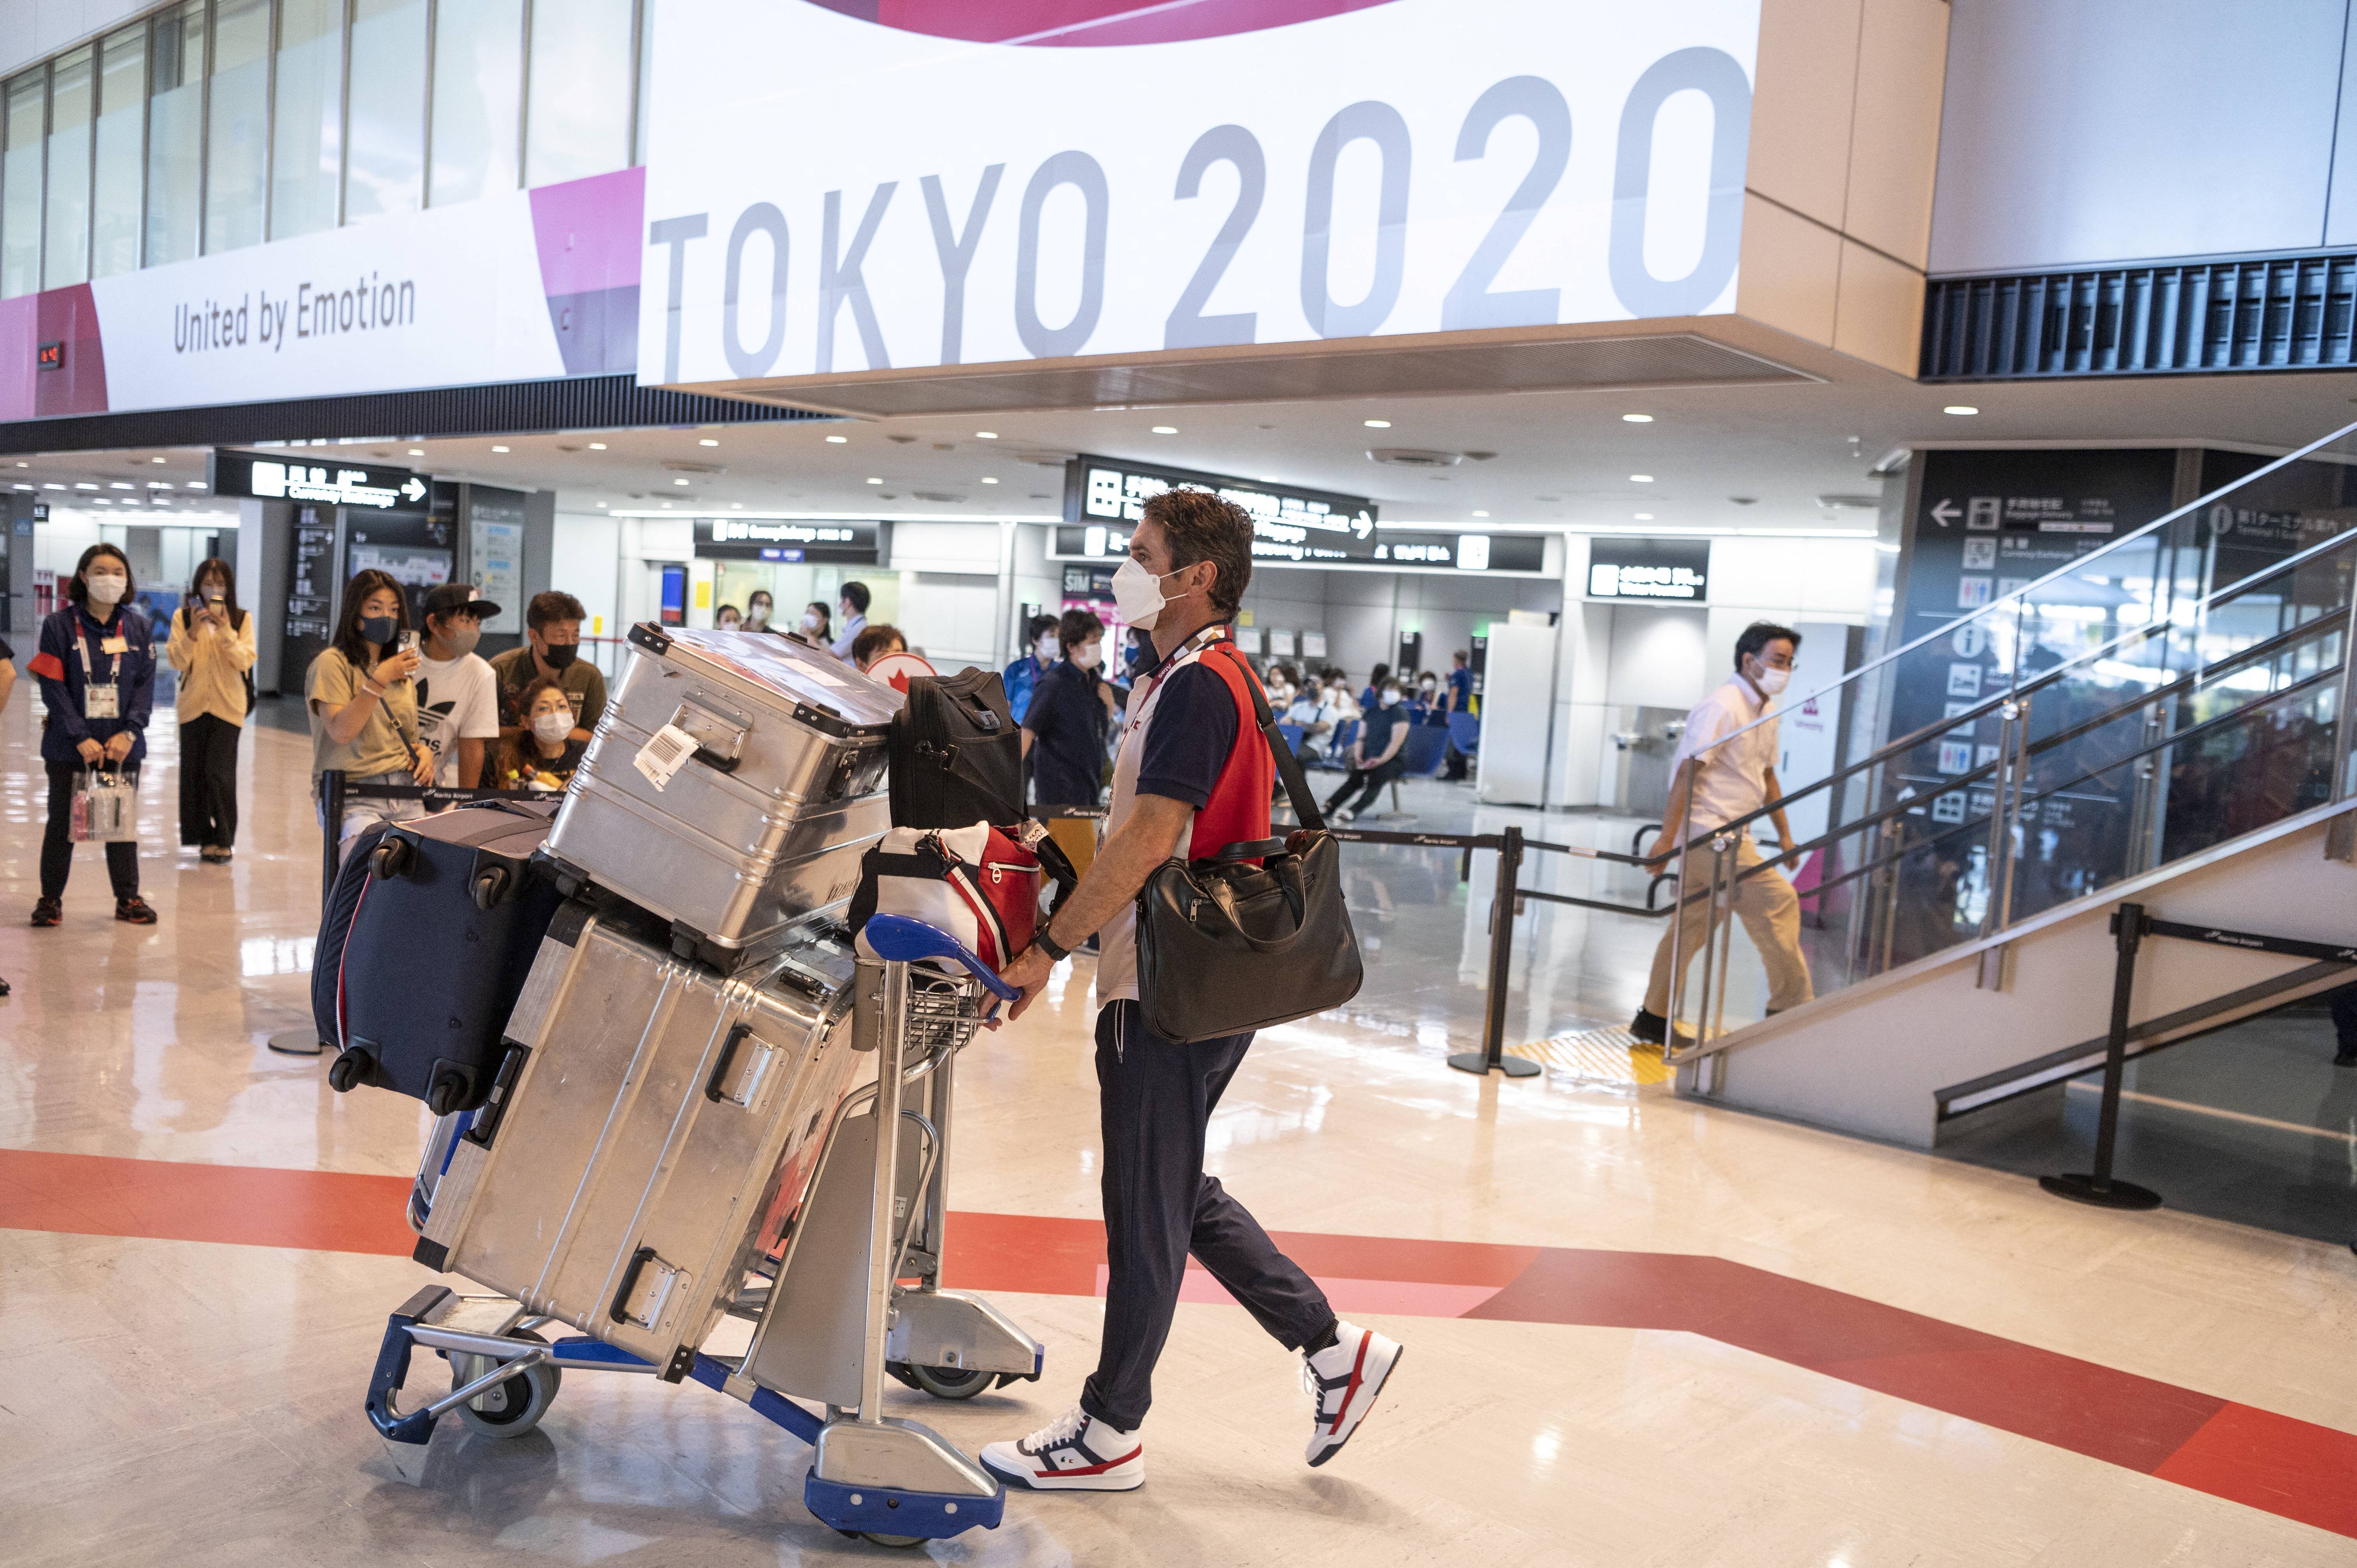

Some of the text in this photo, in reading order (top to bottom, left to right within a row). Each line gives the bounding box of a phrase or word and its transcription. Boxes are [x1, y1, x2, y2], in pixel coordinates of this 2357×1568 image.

[175, 271, 414, 353] United by Emotion
[649, 46, 1754, 384] TOKYO 2020
